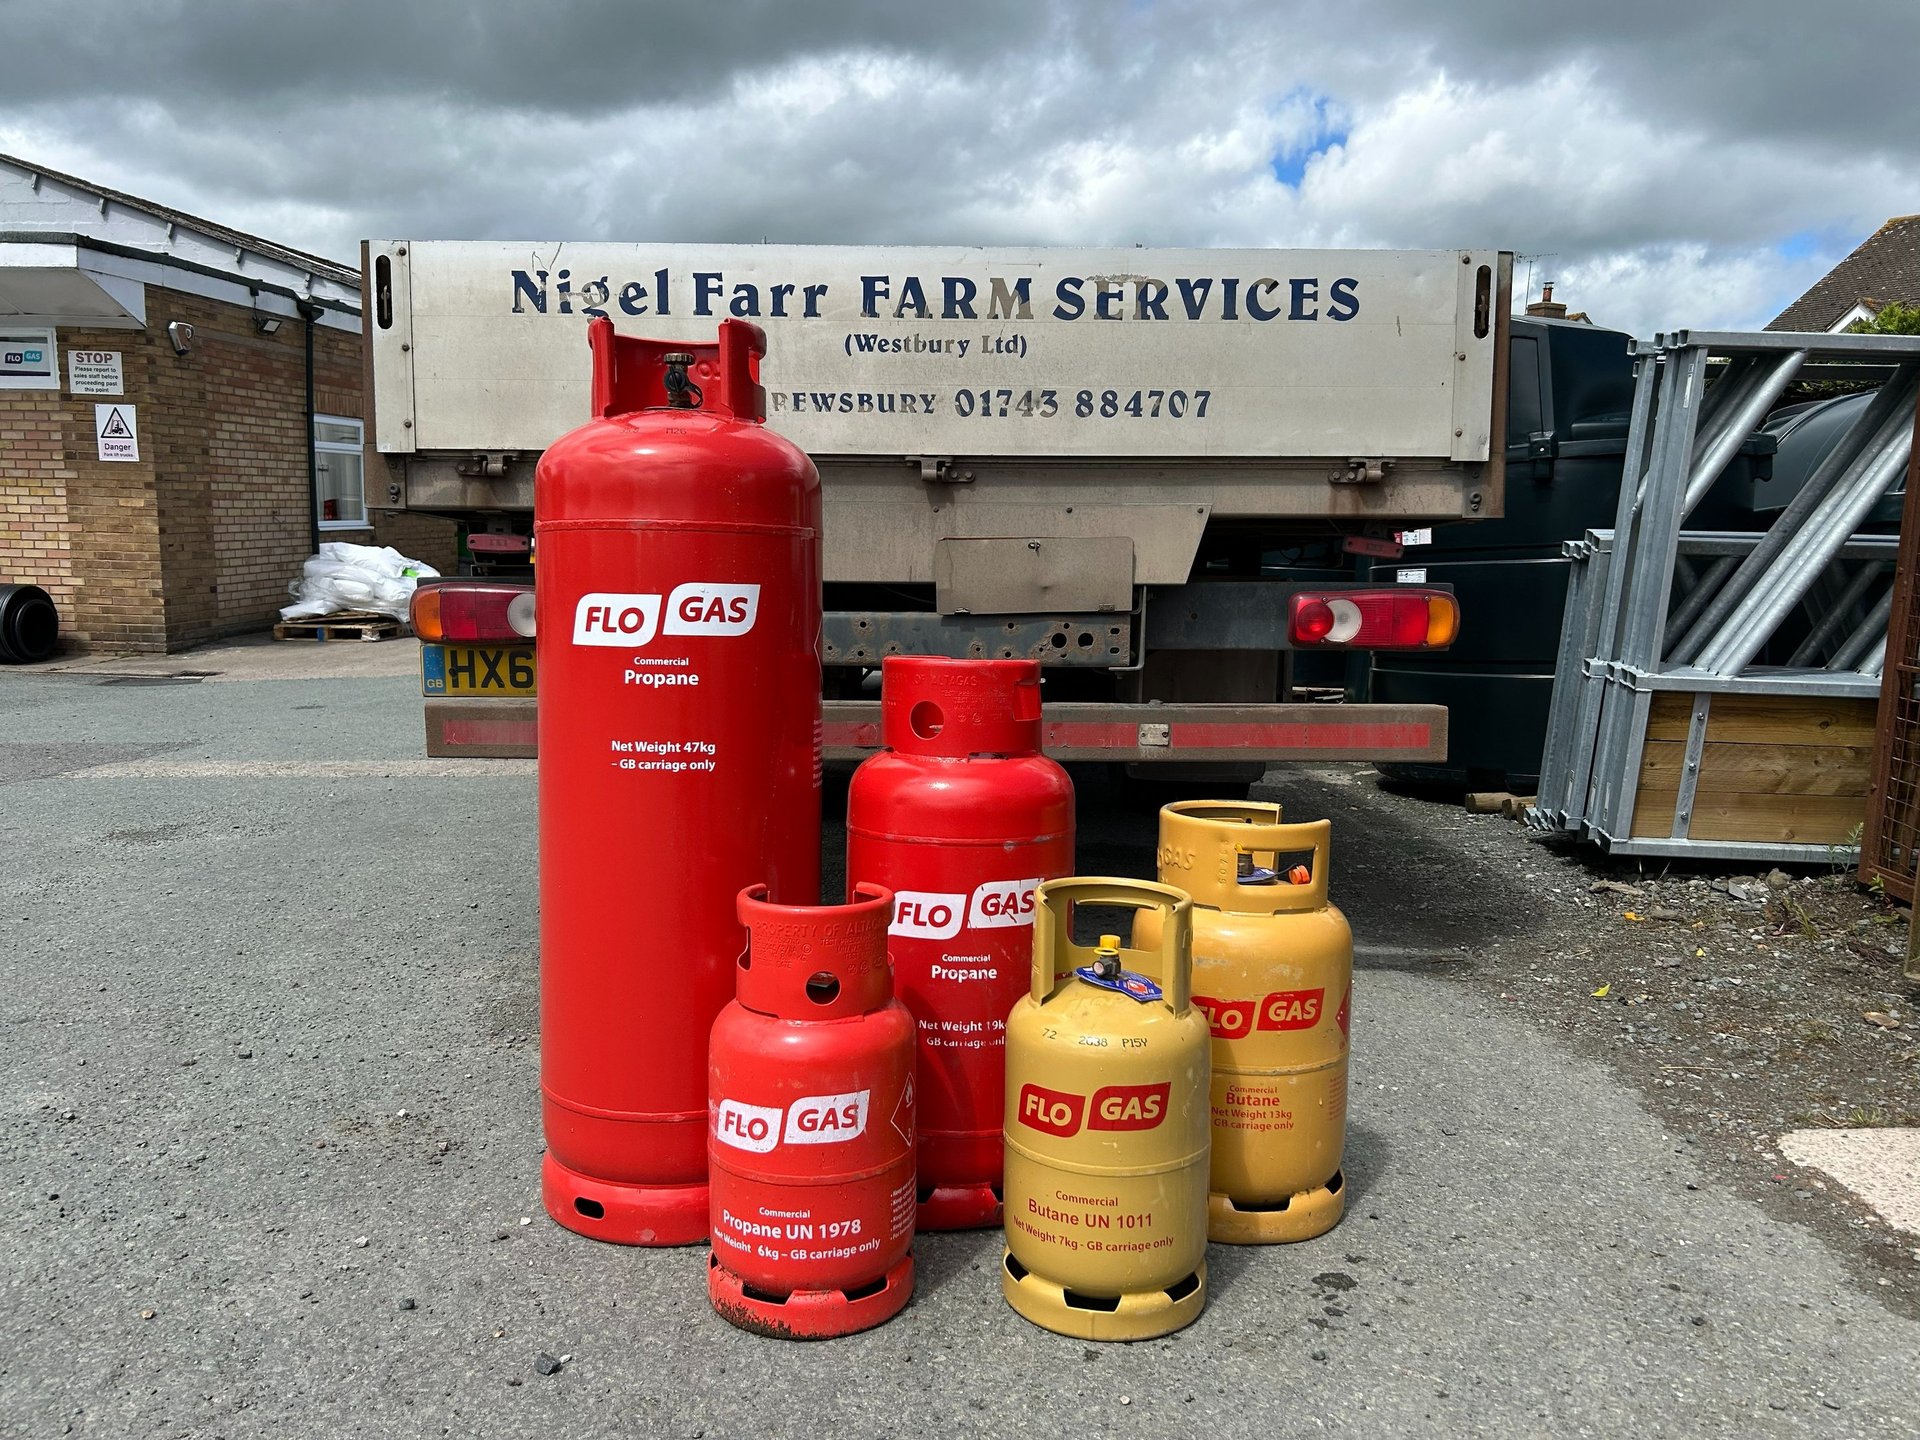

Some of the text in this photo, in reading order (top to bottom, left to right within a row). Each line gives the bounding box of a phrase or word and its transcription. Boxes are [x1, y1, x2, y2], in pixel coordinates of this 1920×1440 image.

[511, 268, 1360, 321] Nigel Farr FARM SERVICES
[844, 333, 1028, 358] (Westbury Ltd)
[25, 352, 41, 360] GAS
[75, 352, 113, 364] STOP
[771, 388, 1212, 418] REWSBURY 01743 884707
[104, 443, 131, 452] Danger
[585, 596, 748, 634] FLO GAS
[427, 650, 534, 689] GB HX6
[633, 656, 689, 666] Commercial
[624, 669, 699, 688] Propane
[611, 740, 716, 755] Net Weight 47kg
[619, 759, 636, 770] GB
[638, 759, 687, 772] carriage
[690, 759, 716, 772] only
[897, 891, 1035, 928] FLO GAS
[941, 953, 991, 963] Commercial
[931, 965, 998, 983] Propane
[1268, 998, 1317, 1022] GAS
[918, 1019, 1006, 1034] Net Weight 19k
[926, 1036, 941, 1046] GB
[989, 1035, 1005, 1046] onl
[1229, 1085, 1278, 1094] Commercial
[1226, 1092, 1280, 1107] Butane
[1025, 1093, 1161, 1127] FLO GAS
[1211, 1106, 1292, 1120] Net Weight 13kg
[724, 1104, 860, 1141] FLO GAS
[1214, 1118, 1228, 1128] GB
[1231, 1121, 1271, 1132] carriage
[1055, 1190, 1119, 1207] Commercial
[758, 1206, 811, 1219] Commercial
[1028, 1198, 1152, 1229] Butane UN 1011
[722, 1209, 862, 1240] Propane UN 1978
[714, 1225, 724, 1240] Net
[723, 1232, 752, 1253] Weight
[757, 1244, 779, 1260] 6kg
[790, 1249, 807, 1260] GB
[810, 1245, 857, 1260] carriage
[859, 1237, 881, 1253] only
[1013, 1215, 1025, 1230] Net
[1025, 1222, 1056, 1244] Weight
[1058, 1235, 1078, 1250] 7kg
[1086, 1240, 1103, 1251] GB
[1105, 1237, 1151, 1253] carriage
[1153, 1235, 1174, 1249] only
